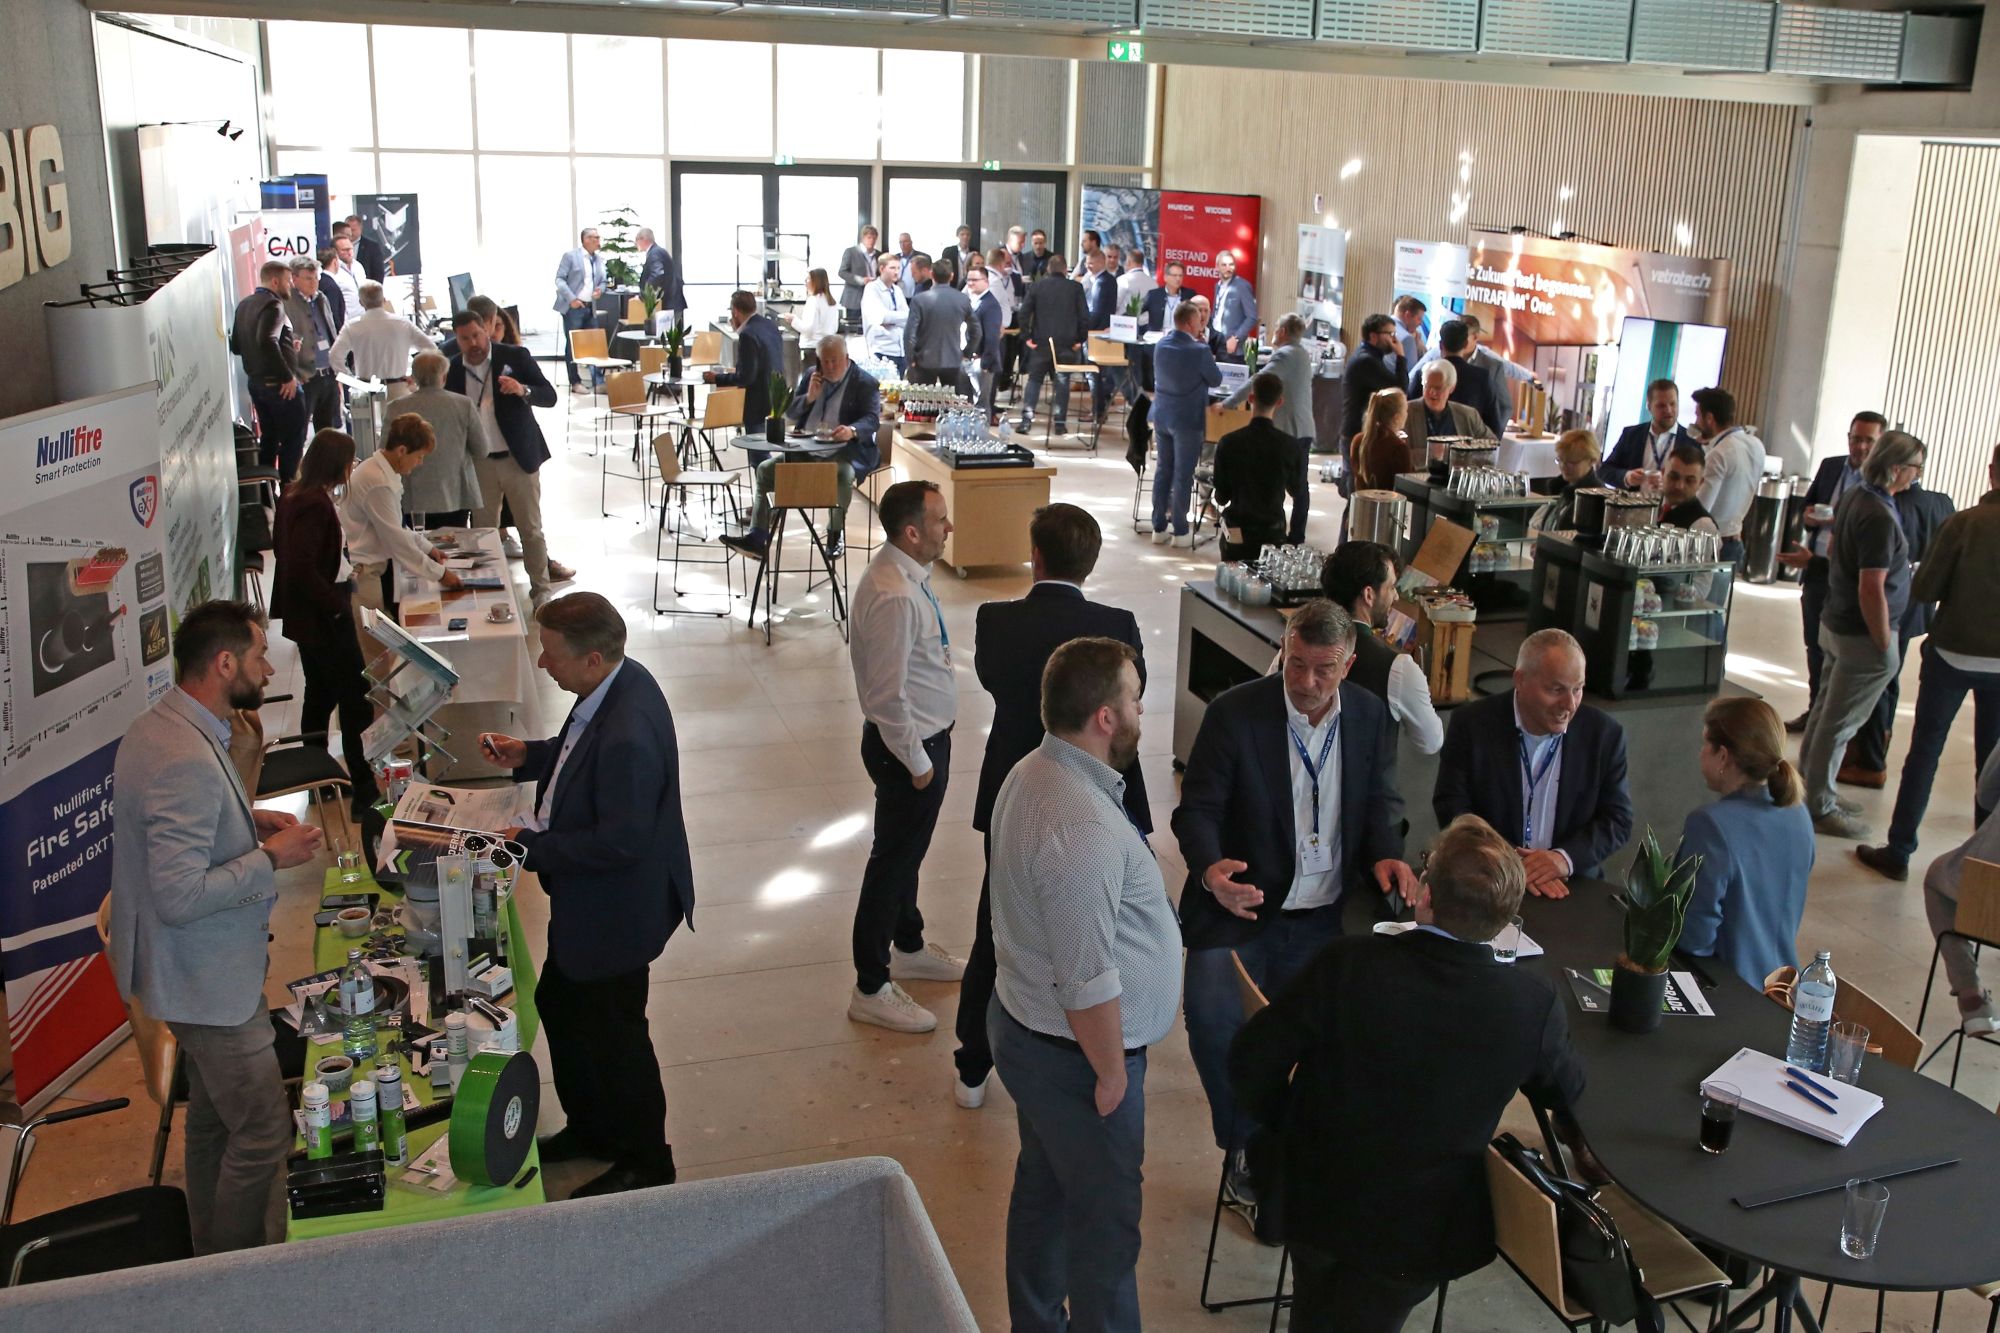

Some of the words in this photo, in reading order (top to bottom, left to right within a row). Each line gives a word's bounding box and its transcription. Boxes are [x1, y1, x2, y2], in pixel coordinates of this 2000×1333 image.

[0, 124, 71, 290] BIG
[268, 236, 310, 256] CAD
[1165, 249, 1208, 262] BESTAND
[1186, 265, 1220, 279] DENKE
[1651, 268, 1712, 289] vetrotech
[36, 425, 103, 469] Nullifire
[35, 468, 60, 485] Smart
[62, 457, 101, 476] Protection
[53, 783, 102, 821] Nullifire
[27, 828, 70, 867] Fire
[32, 853, 84, 895] Patented
[86, 837, 108, 860] GXT
